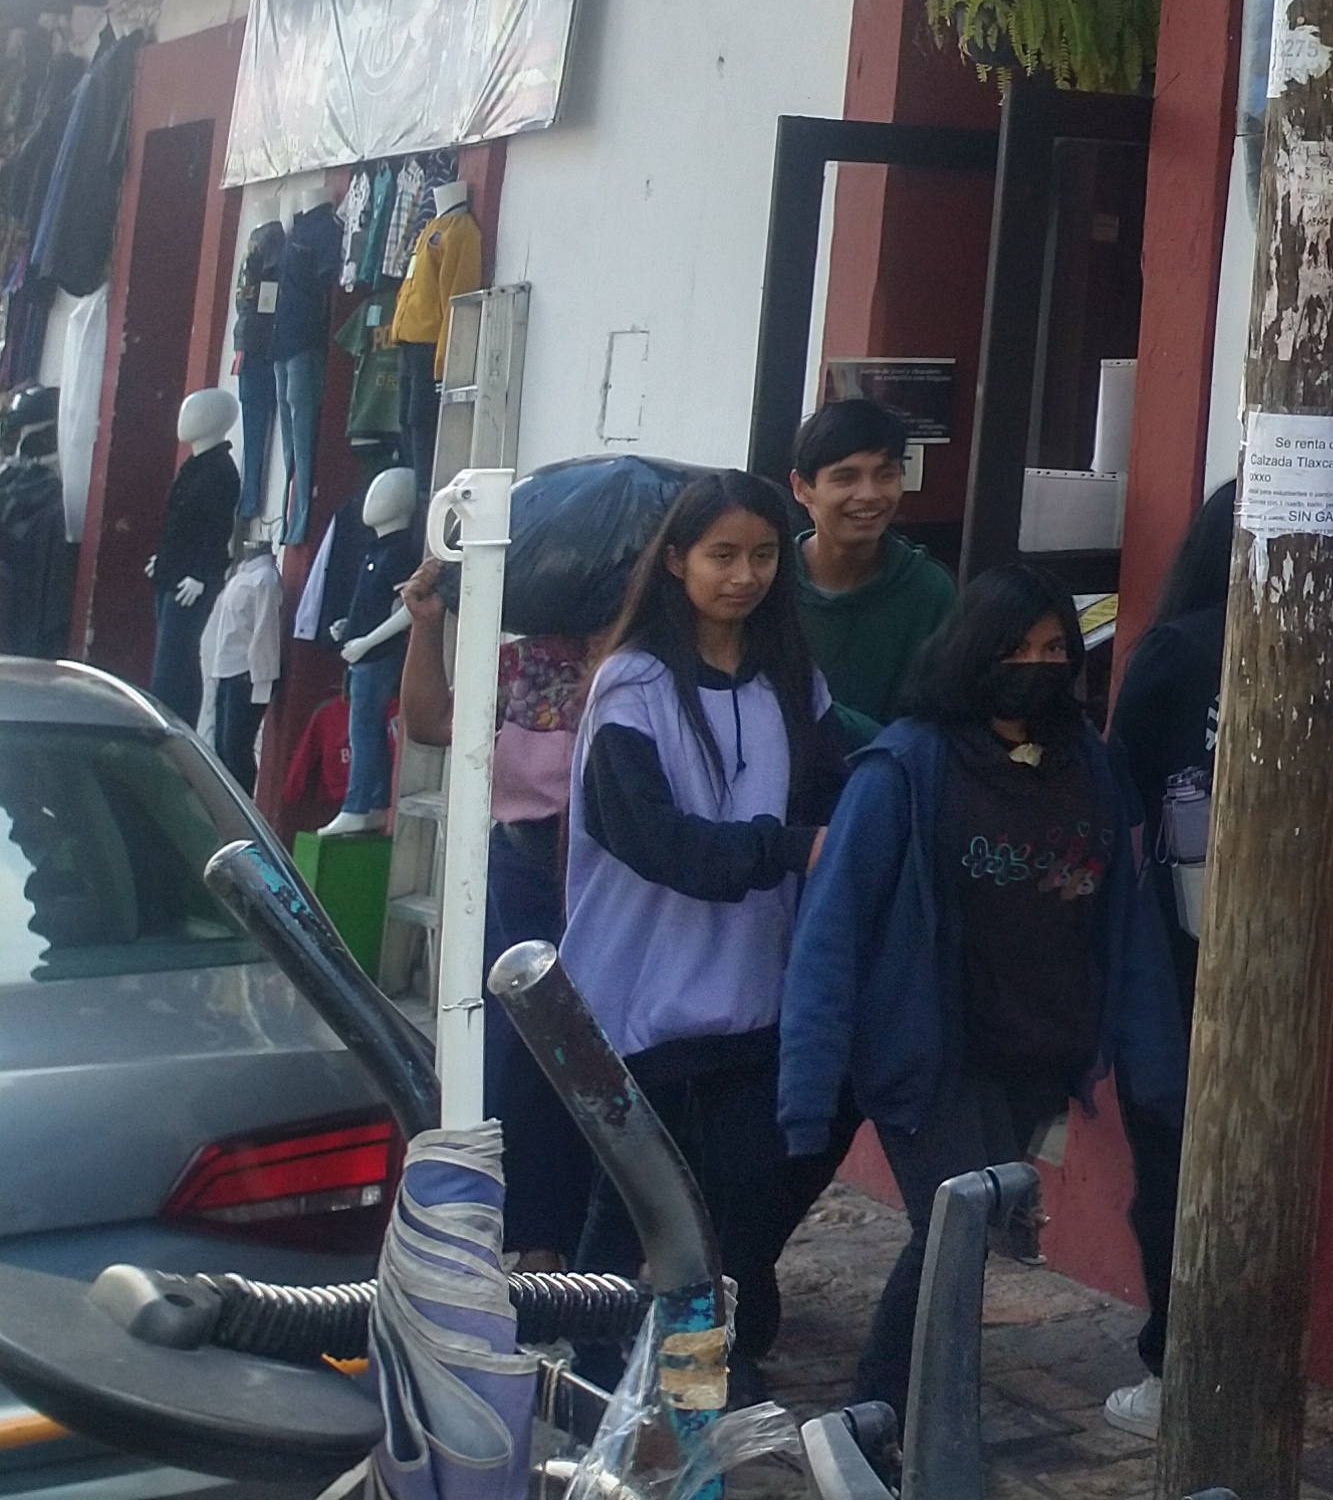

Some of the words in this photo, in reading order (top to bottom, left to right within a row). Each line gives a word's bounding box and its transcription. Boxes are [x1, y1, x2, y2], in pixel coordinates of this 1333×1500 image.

[1275, 437, 1291, 448] Se
[1295, 439, 1326, 449] renta
[1250, 454, 1292, 467] Calzada
[1288, 511, 1311, 522] SIN
